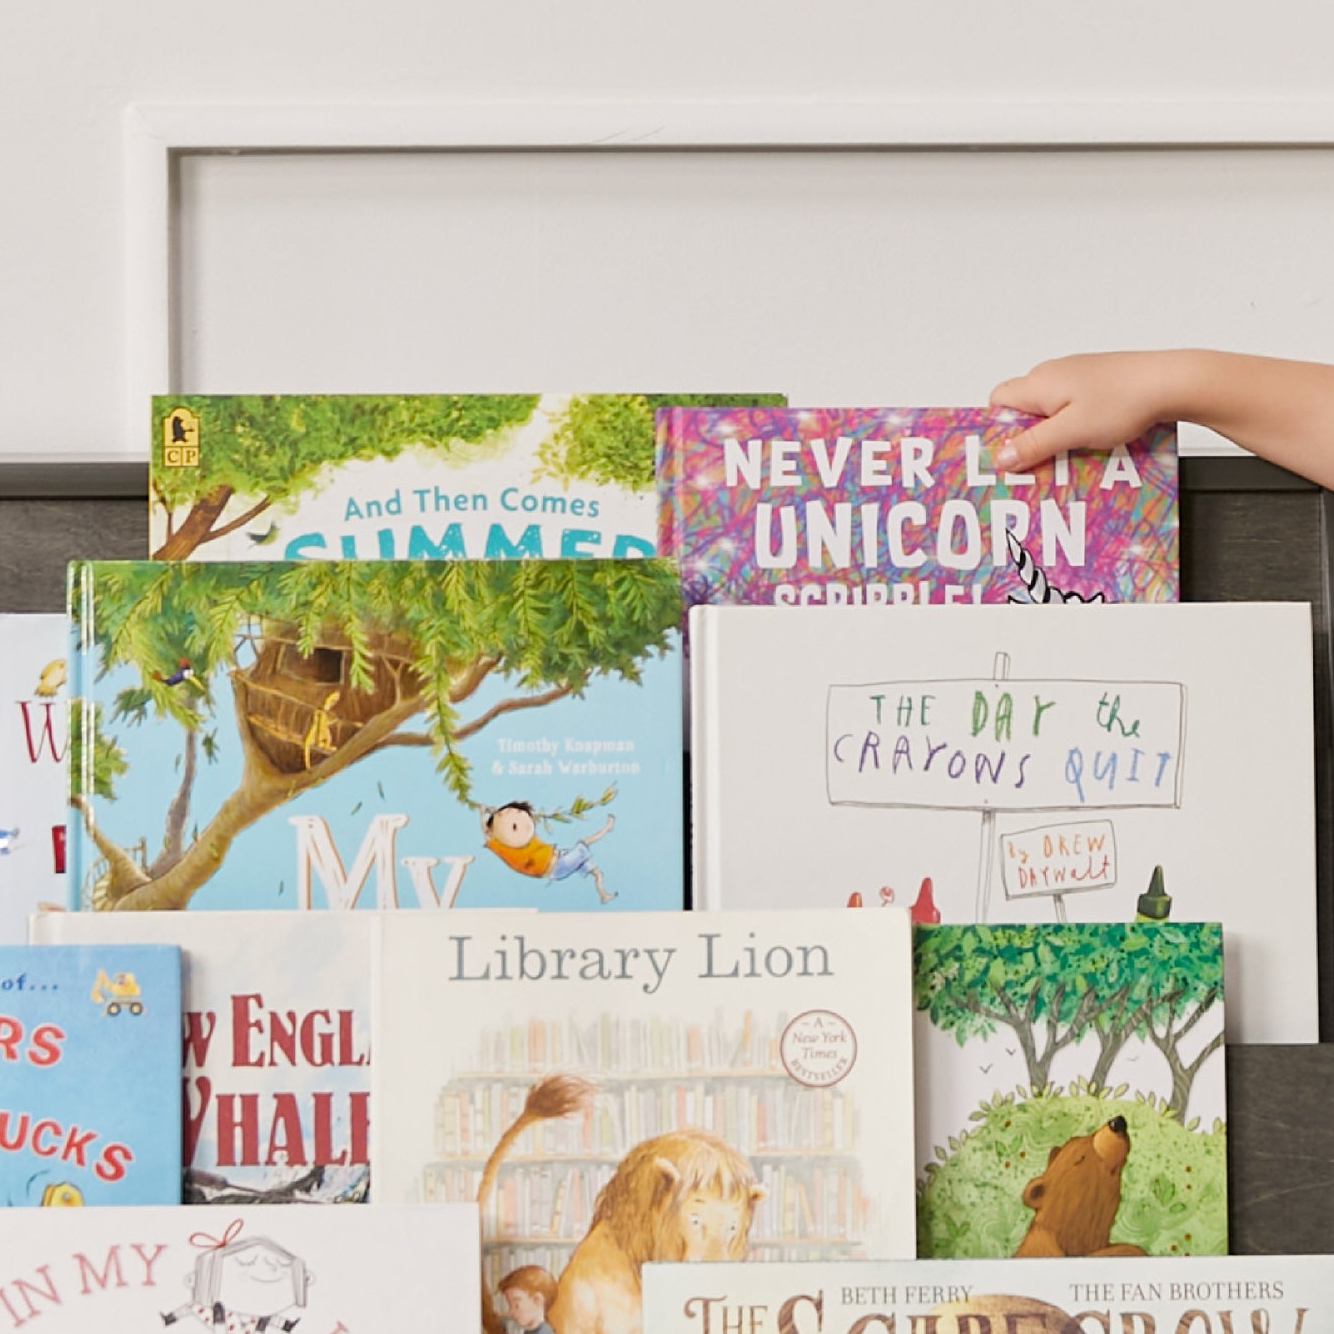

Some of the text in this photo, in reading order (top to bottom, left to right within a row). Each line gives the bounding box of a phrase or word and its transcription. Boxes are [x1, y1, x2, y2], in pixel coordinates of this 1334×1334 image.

[723, 436, 936, 490] NEVER
[1100, 443, 1142, 490] A
[345, 487, 599, 521] And Then Comes
[755, 500, 1087, 570] UNICORN
[870, 690, 1140, 742] THE DAY the
[497, 737, 559, 756] Timothy
[508, 760, 552, 775] Sarah
[834, 731, 1171, 803] CRAYONS QUIT
[1, 973, 59, 992] of...
[449, 933, 834, 994] Library Lion
[231, 993, 370, 1067] ENGL
[792, 1031, 847, 1044] New York
[73, 1243, 170, 1295] MY
[841, 1285, 974, 1305] BETH FERRY
[1071, 1280, 1285, 1302] THE FAN BROTHERS
